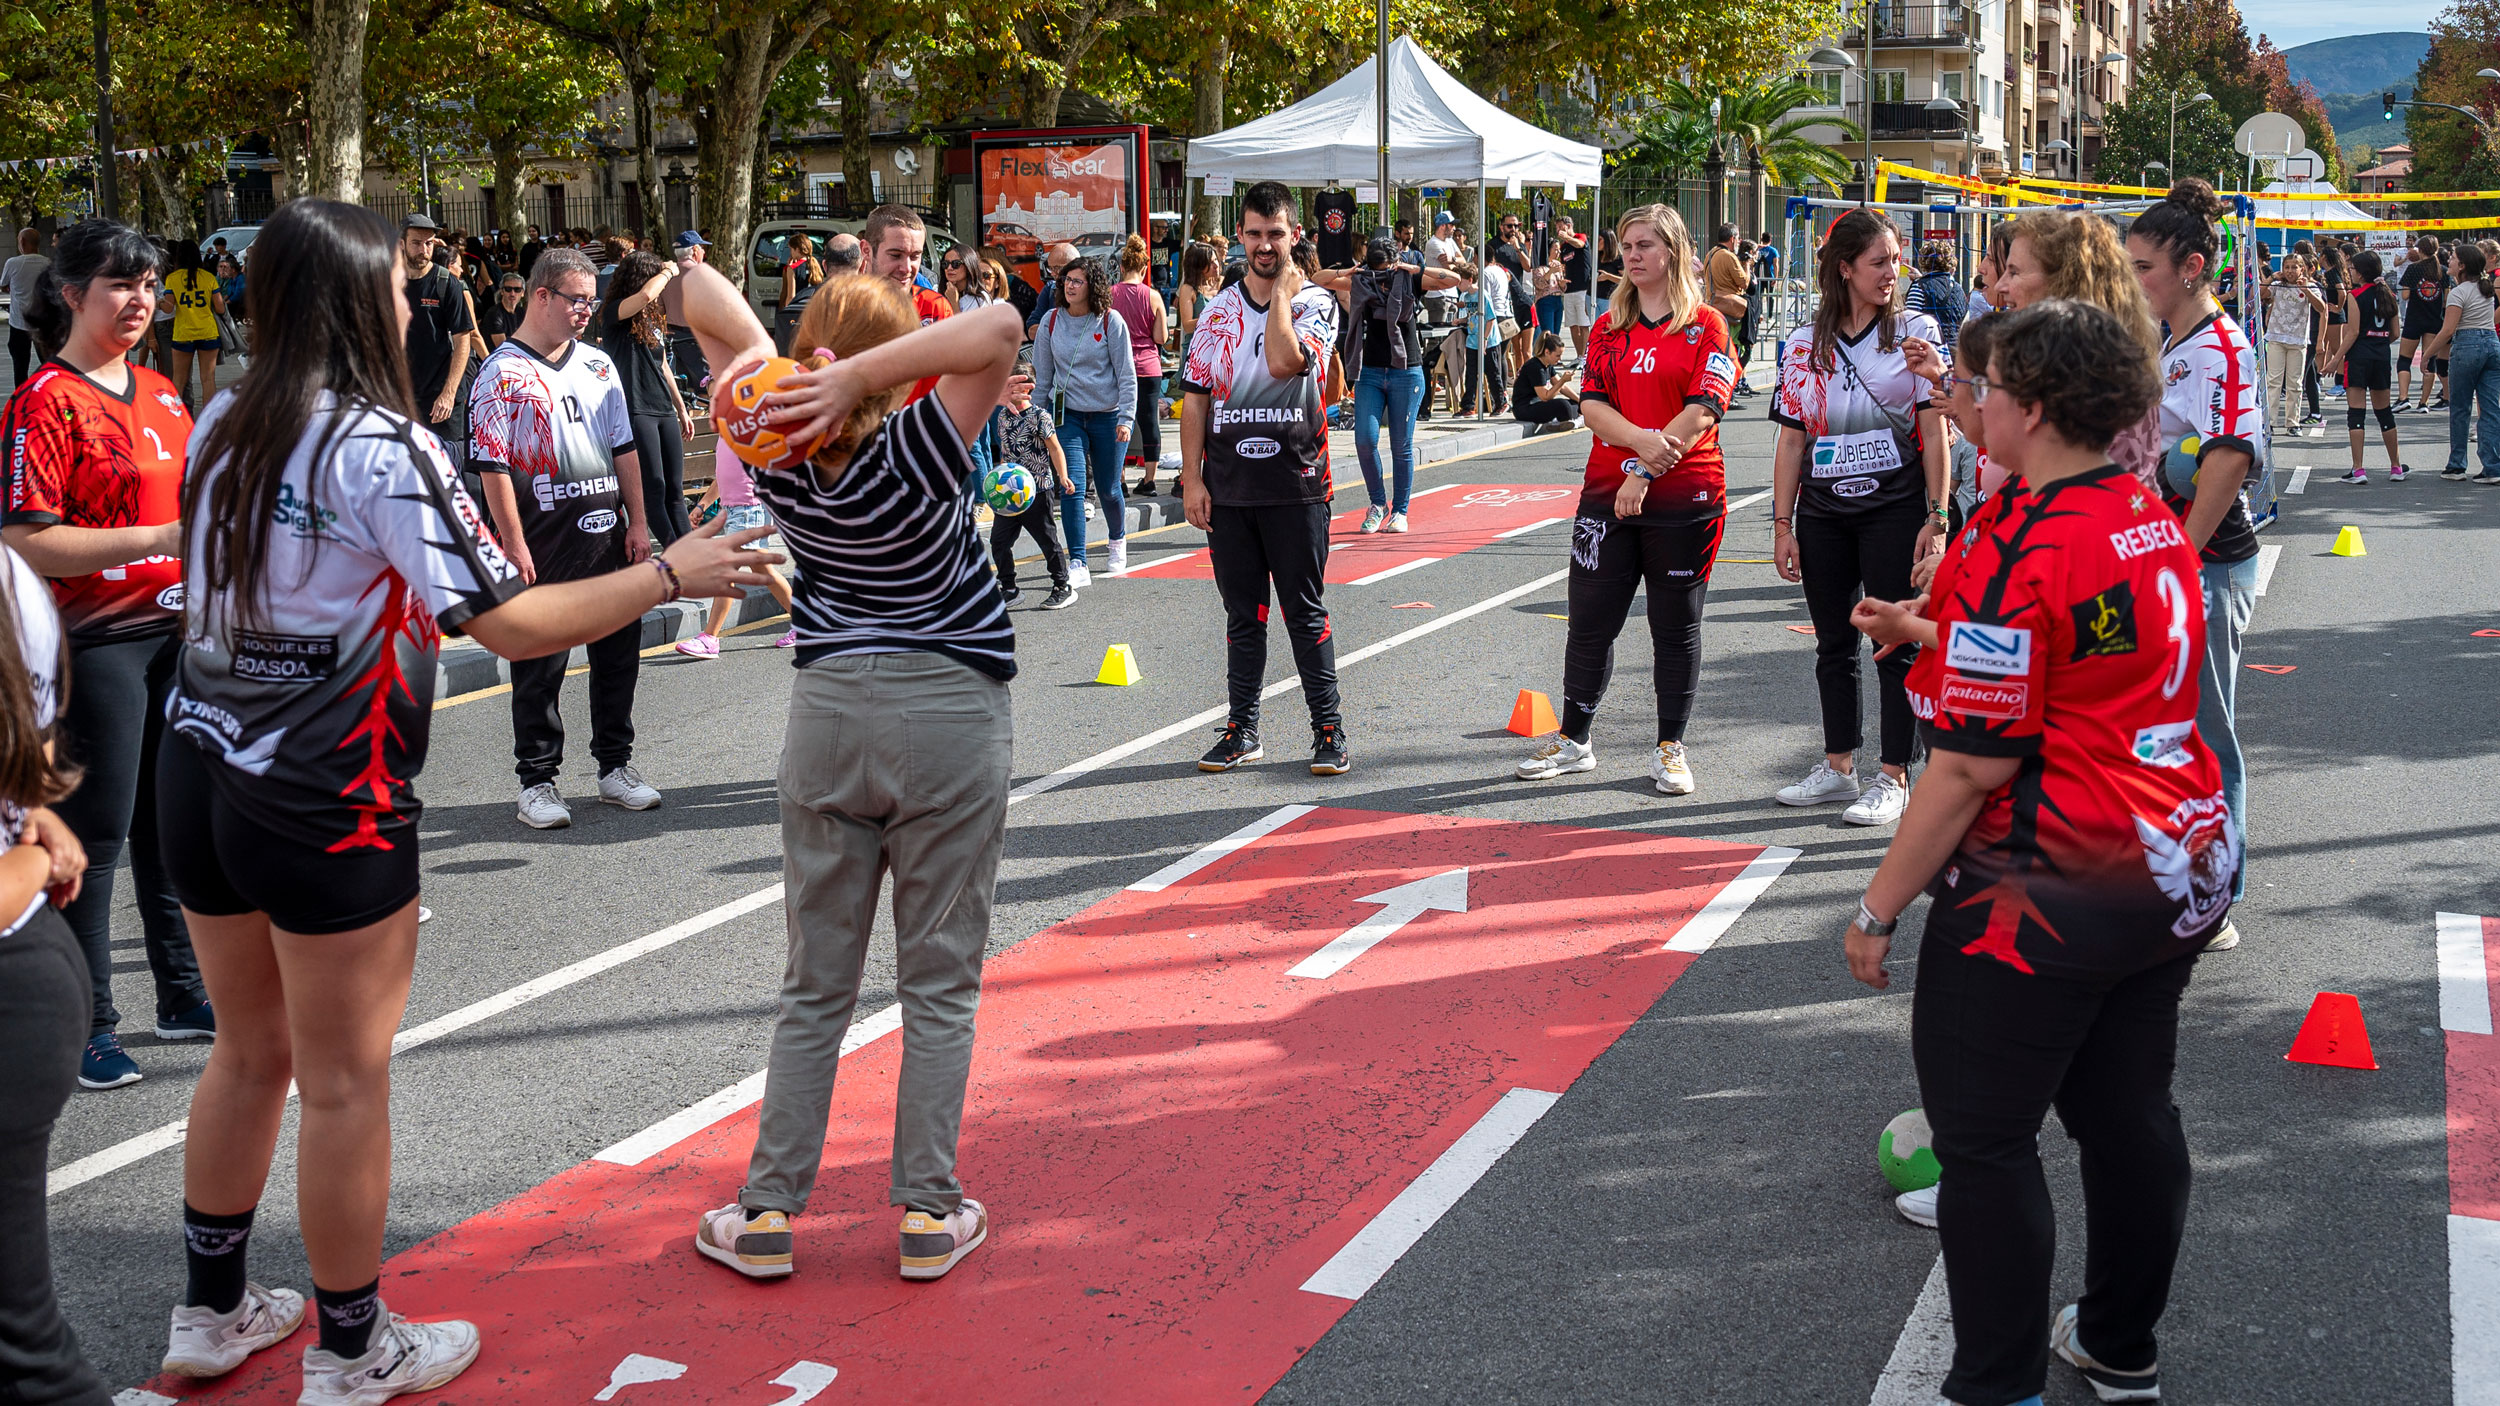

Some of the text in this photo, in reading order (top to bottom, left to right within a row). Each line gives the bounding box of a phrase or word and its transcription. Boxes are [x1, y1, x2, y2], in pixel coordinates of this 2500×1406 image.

[180, 290, 206, 308] 45
[1630, 347, 1657, 374] 26
[560, 394, 583, 424] 12
[143, 427, 172, 461] 2
[1257, 447, 1276, 455] BAR
[1835, 440, 1894, 464] ZUBIEDER
[12, 428, 27, 508] TXINGUDI
[1814, 458, 1897, 476] CONSTRUCCIONES
[1855, 484, 1875, 493] BAR
[600, 517, 616, 529] BAR
[2109, 520, 2185, 561] REBECA
[2156, 565, 2190, 701] 3
[237, 638, 333, 655] ROQUELES
[1945, 685, 2021, 704] patacho
